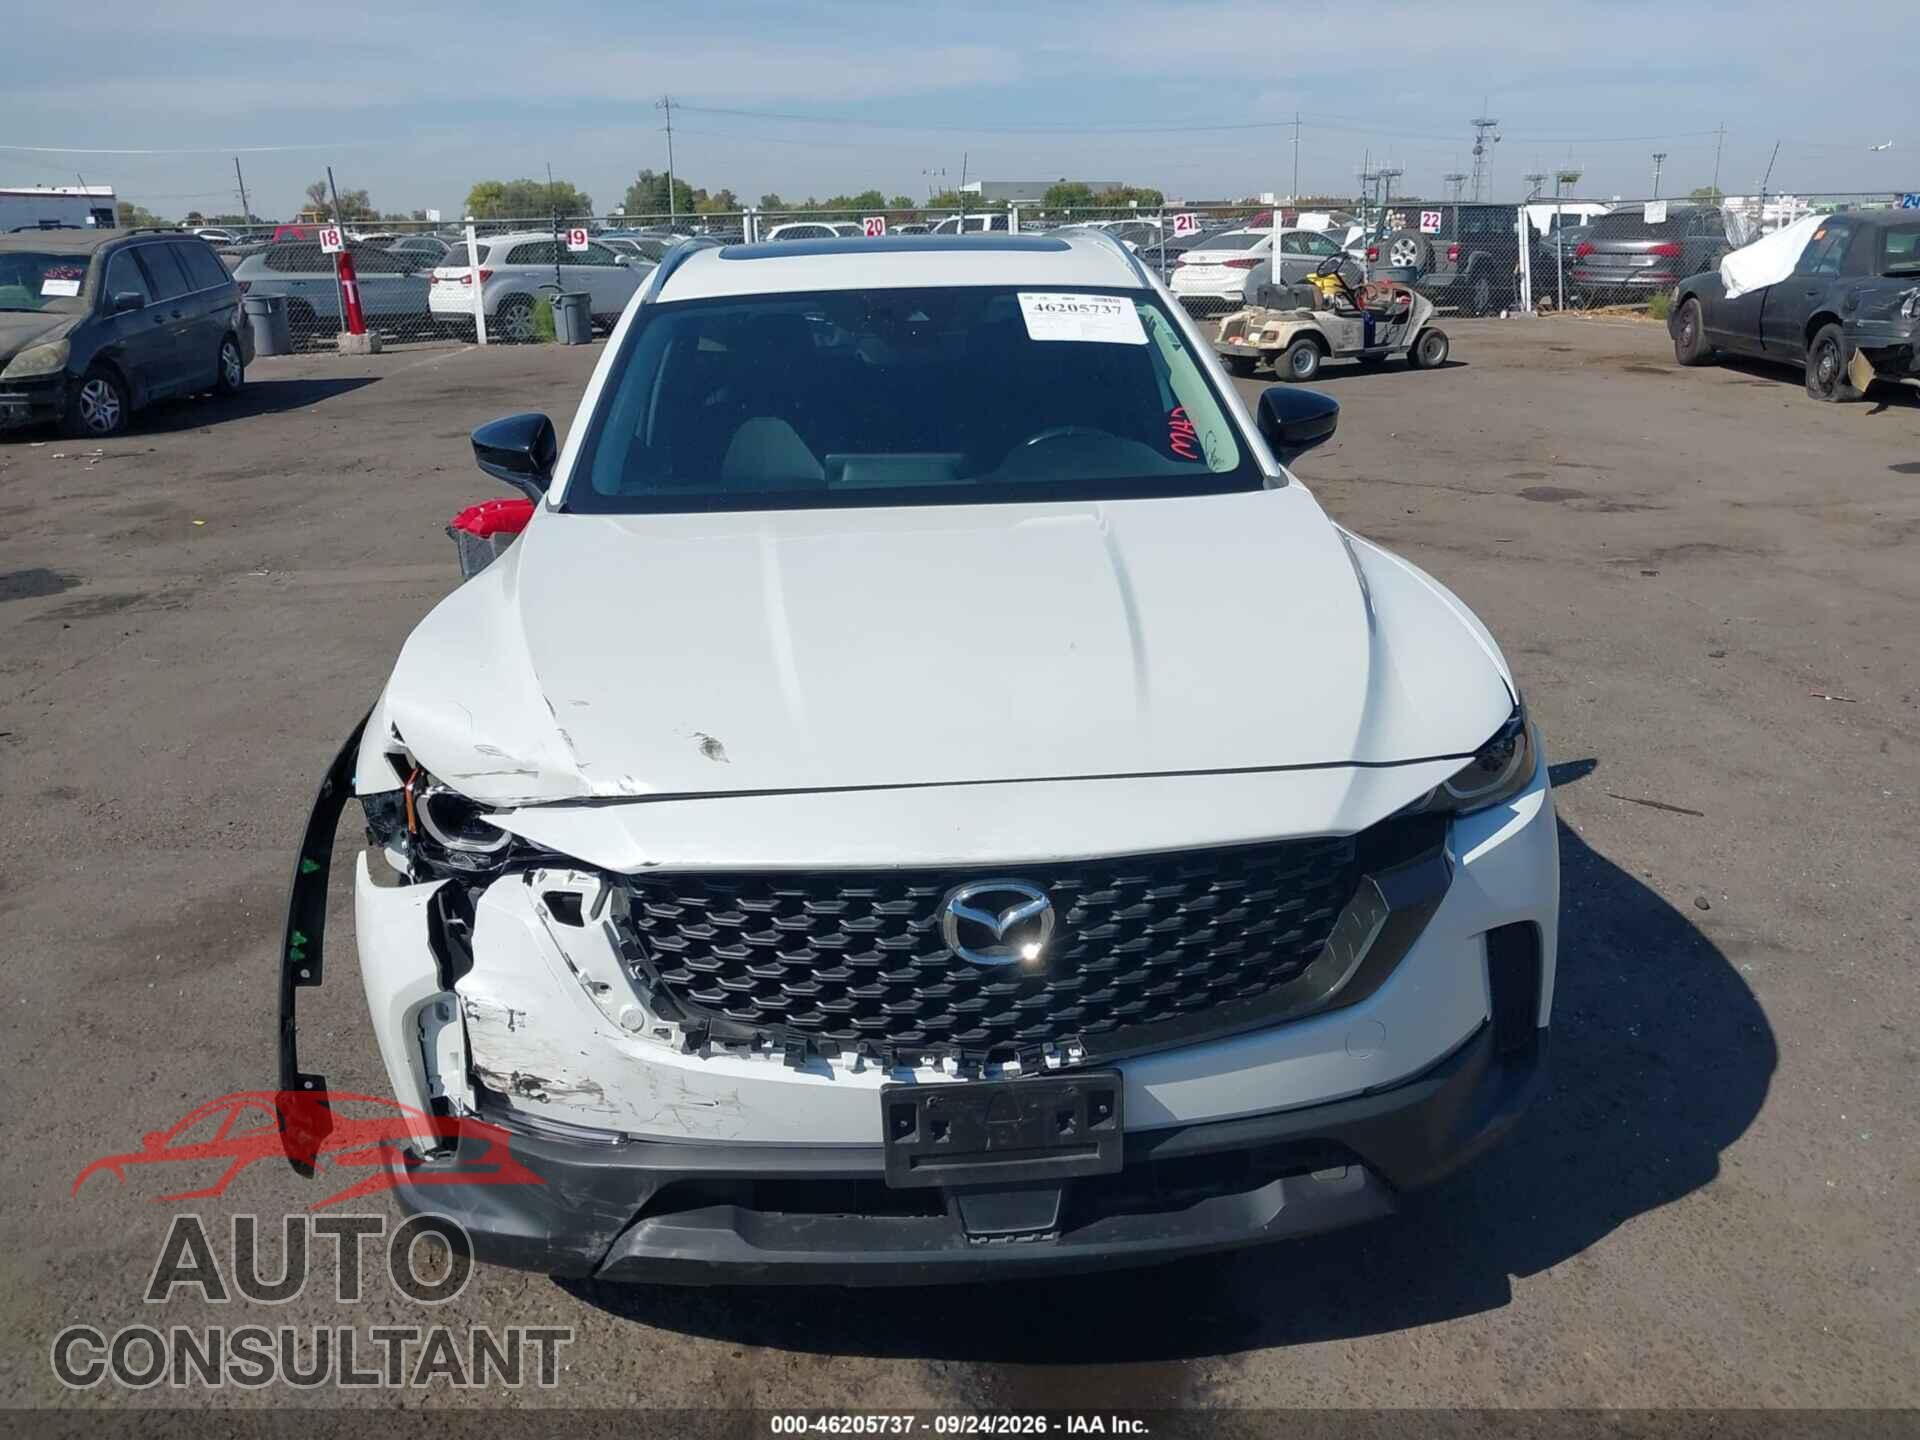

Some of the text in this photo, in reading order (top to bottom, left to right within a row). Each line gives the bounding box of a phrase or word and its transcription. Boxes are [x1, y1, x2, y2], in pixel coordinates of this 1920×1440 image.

[865, 219, 883, 236] 20
[1176, 215, 1193, 230] 21
[1423, 213, 1439, 227] 22
[321, 230, 340, 247] 18
[567, 230, 586, 245] 19
[1033, 303, 1122, 315] 46205737
